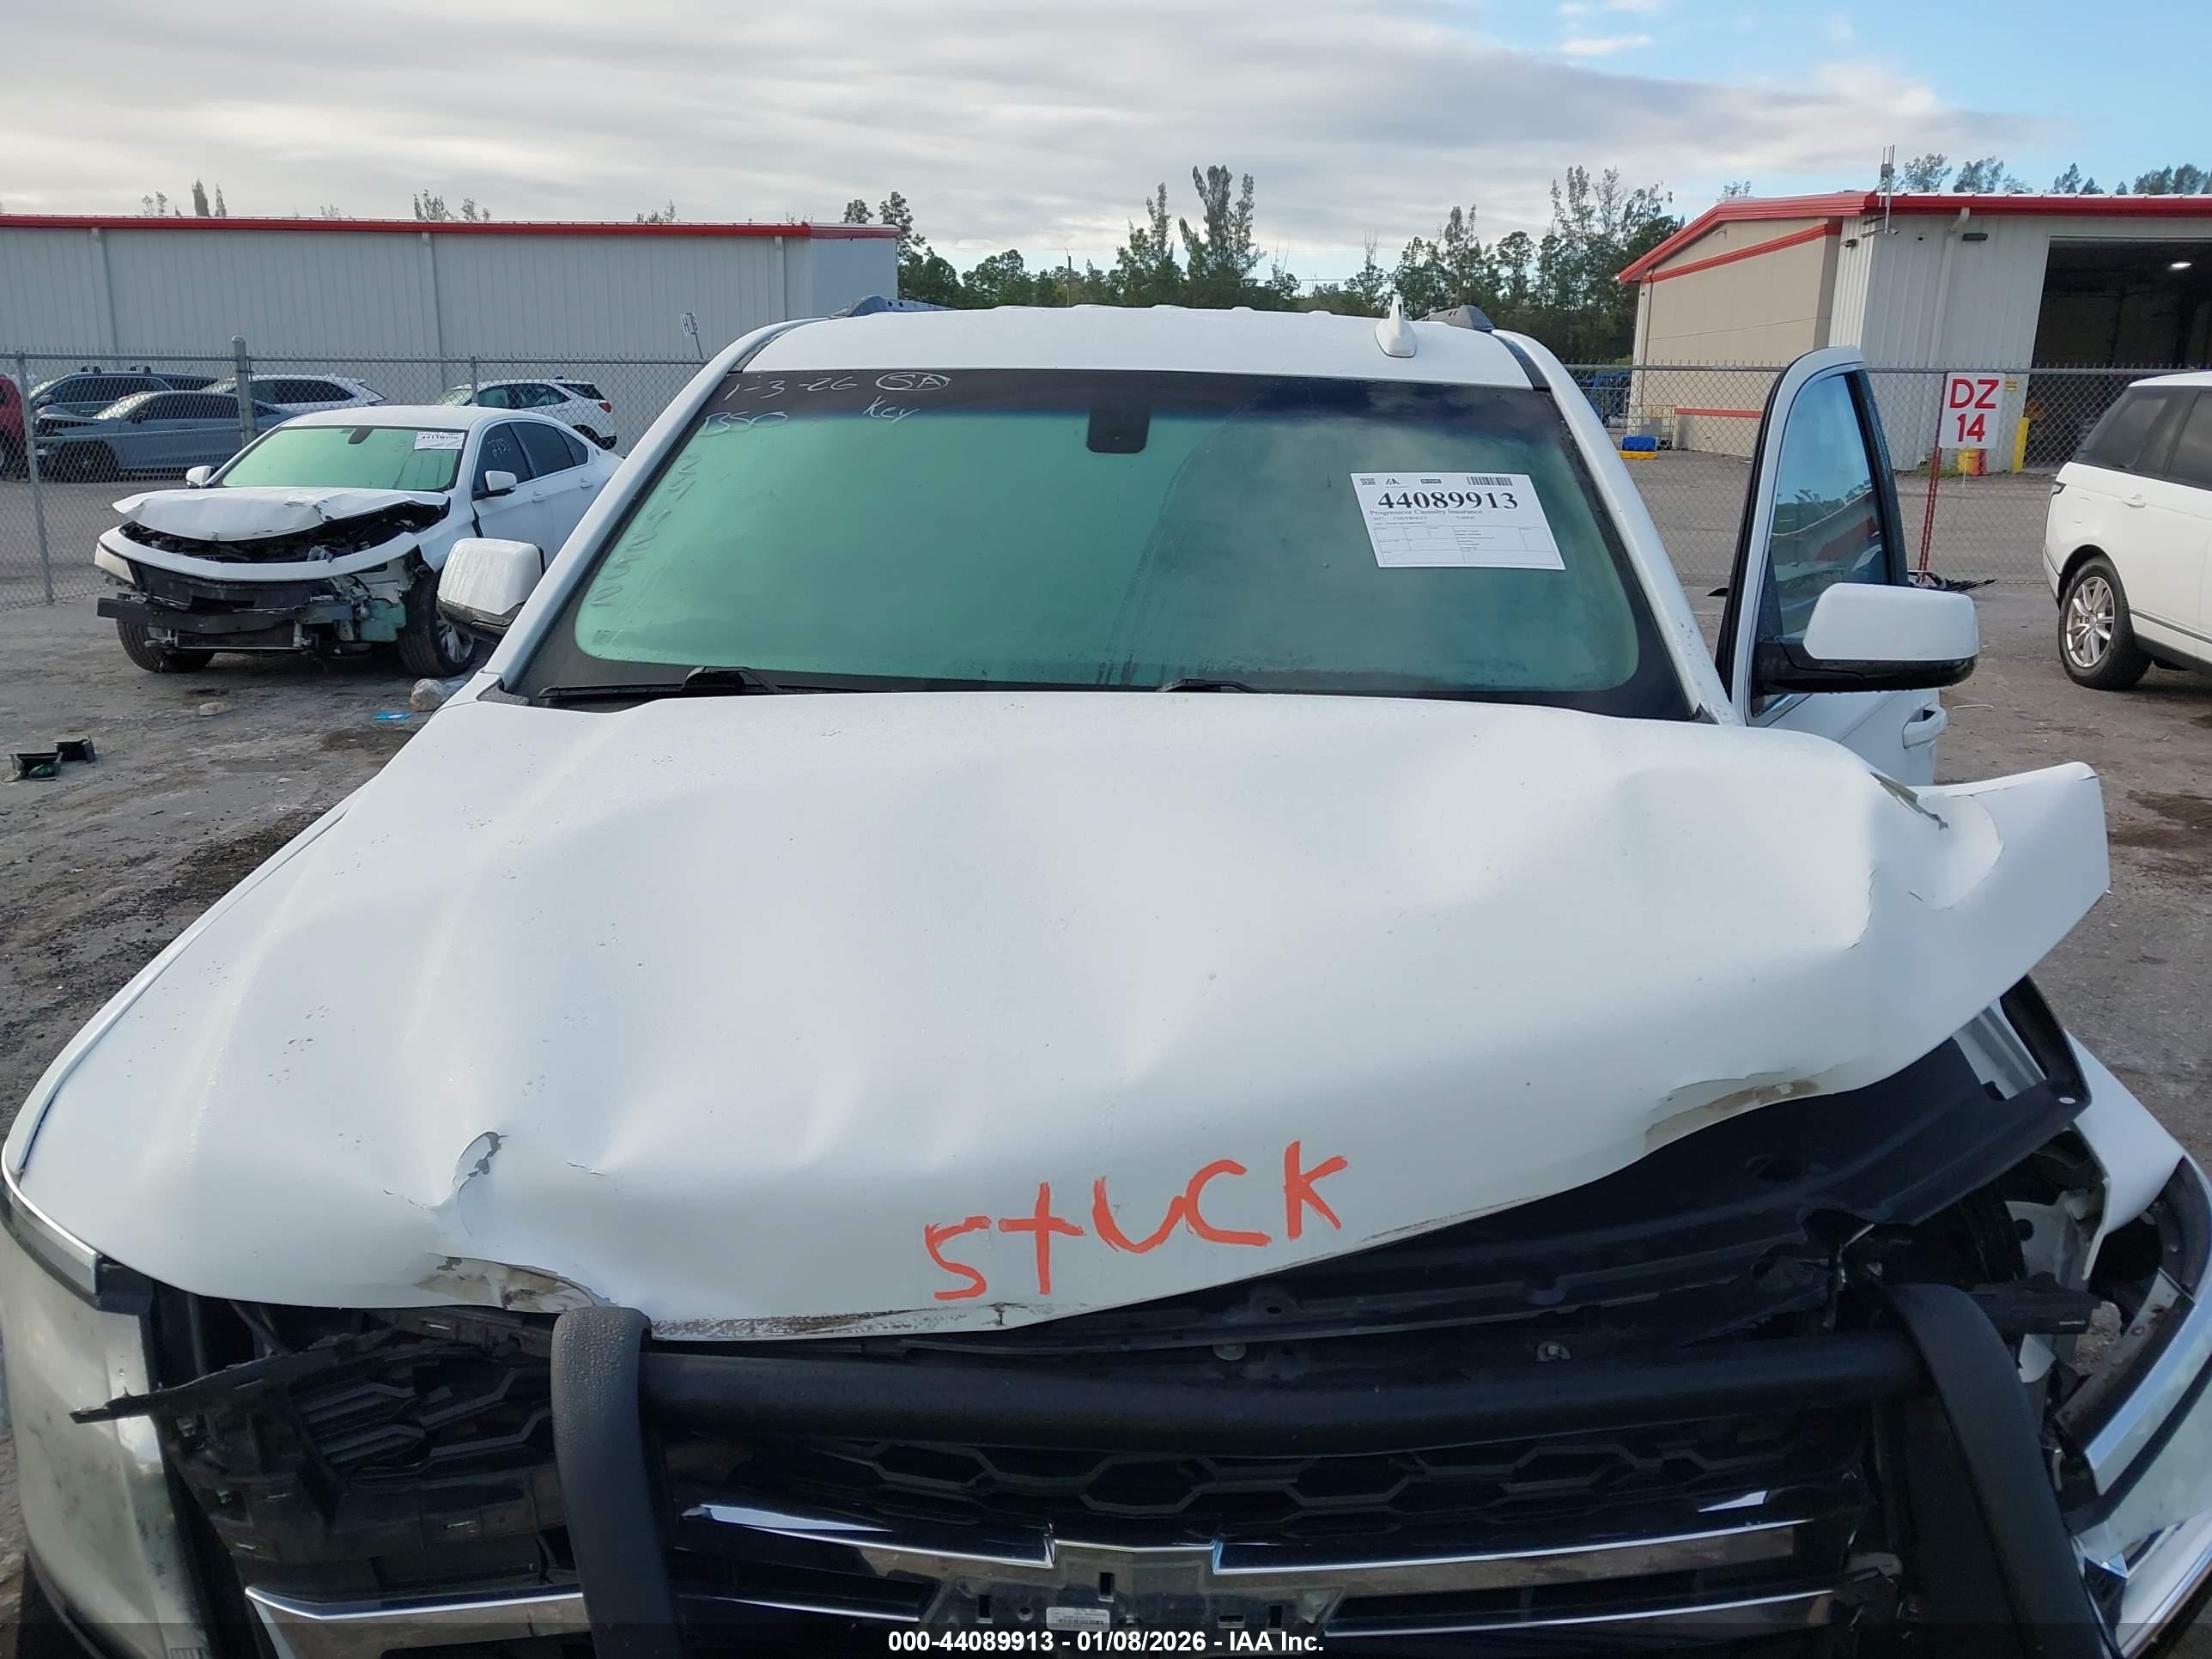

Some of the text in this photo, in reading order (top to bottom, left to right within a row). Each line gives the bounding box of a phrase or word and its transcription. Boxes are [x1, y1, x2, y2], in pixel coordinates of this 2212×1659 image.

[1949, 379, 2000, 409] DZ
[1956, 413, 1985, 442] 14
[1378, 491, 1518, 508] 44089913
